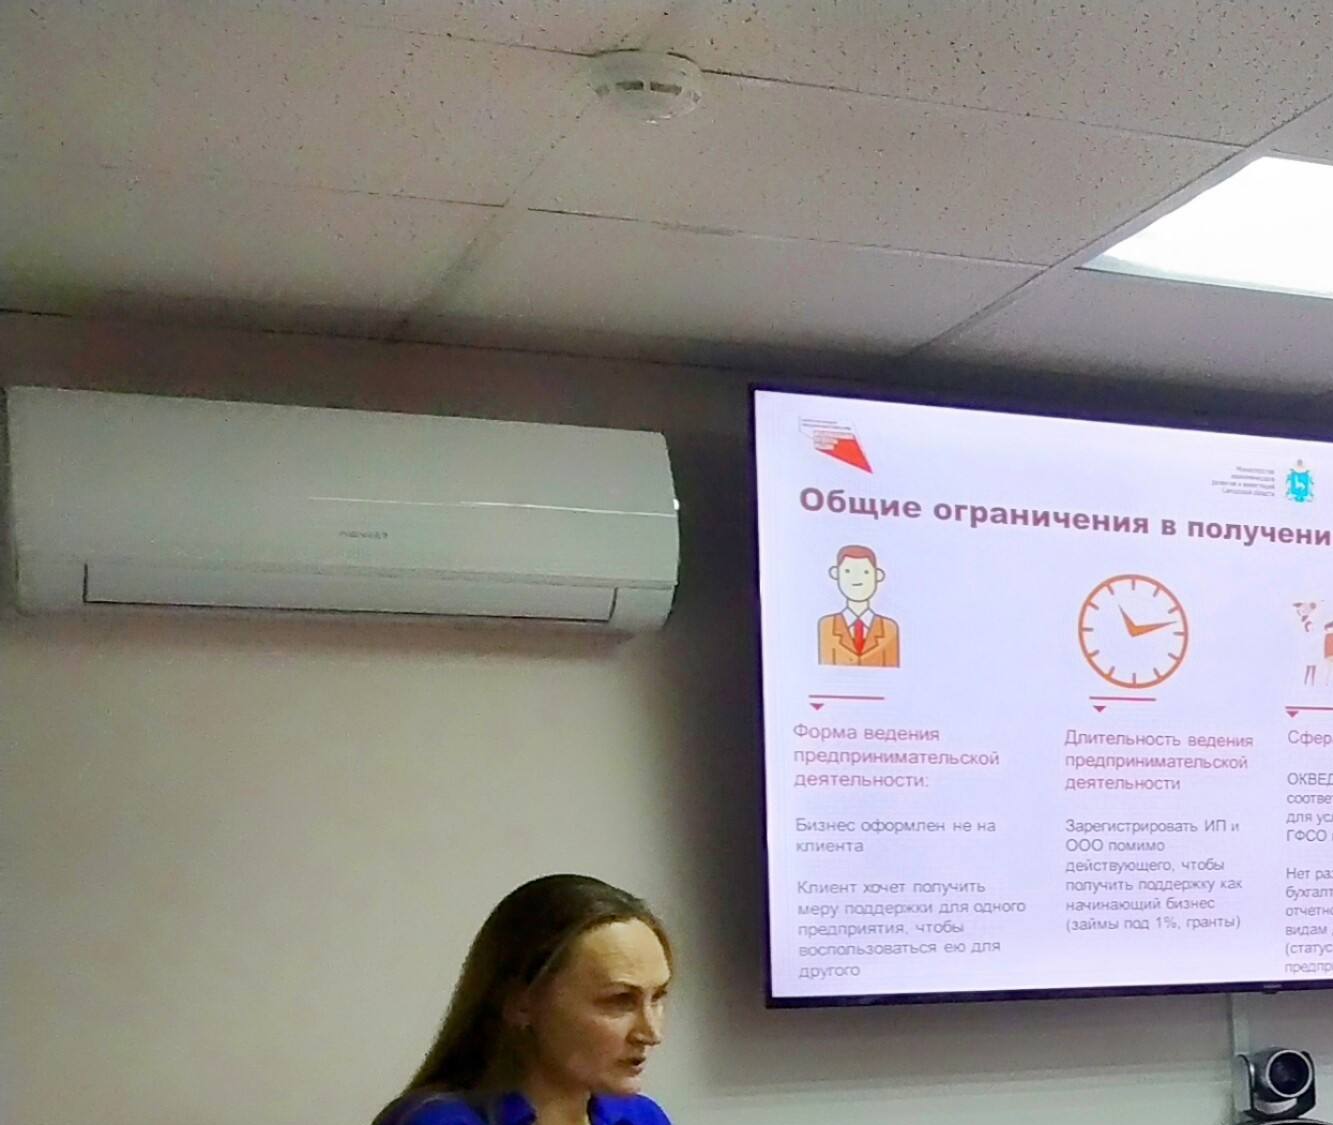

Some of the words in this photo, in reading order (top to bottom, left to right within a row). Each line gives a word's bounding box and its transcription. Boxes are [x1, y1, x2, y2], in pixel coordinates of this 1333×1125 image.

[800, 487, 922, 520] Общие
[934, 502, 1149, 535] ограничения
[1162, 519, 1176, 536] в
[793, 723, 857, 742] Форма
[864, 728, 940, 742] ведения
[1065, 730, 1181, 747] Длительность
[1188, 735, 1253, 748] ведения
[794, 748, 1000, 766] предпринимательской
[1065, 754, 1248, 770] предпринимательской
[794, 773, 929, 788] деятельности:
[1065, 777, 1181, 791] деятельности
[796, 818, 856, 832] Бизнес
[861, 819, 945, 834] оформлен
[953, 820, 972, 832] не
[978, 820, 996, 832] на
[1286, 812, 1313, 824] для
[1066, 819, 1198, 836] Зарегистрировать
[1205, 820, 1226, 832] ИП
[796, 840, 864, 852] клиента
[1066, 840, 1104, 852] ООО
[1108, 841, 1164, 851] помимо
[1065, 860, 1176, 874] действующего,
[1182, 859, 1224, 871] чтобы
[1286, 868, 1310, 880] Нет
[797, 882, 856, 894] Клиент
[863, 882, 905, 894] хочет
[913, 881, 986, 897] получить
[1066, 879, 1134, 894] получить
[1139, 879, 1215, 893] поддержку
[1220, 879, 1242, 890] как
[798, 902, 838, 917] меру
[845, 902, 932, 916] поддержки
[939, 901, 968, 914] для
[974, 901, 1026, 914] одного
[1066, 897, 1161, 912] начинающий
[1166, 897, 1215, 909] бизнес
[798, 922, 908, 938] предприятия,
[916, 920, 964, 934] чтобы
[1066, 916, 1119, 934] (займы
[1124, 918, 1150, 930] под
[1186, 915, 1241, 930] гранты)
[1286, 924, 1327, 936] видам
[799, 942, 936, 957] воспользоваться
[944, 942, 965, 953] ею
[971, 940, 1000, 954] для
[1285, 941, 1333, 957] (статус
[799, 965, 860, 980] другого
